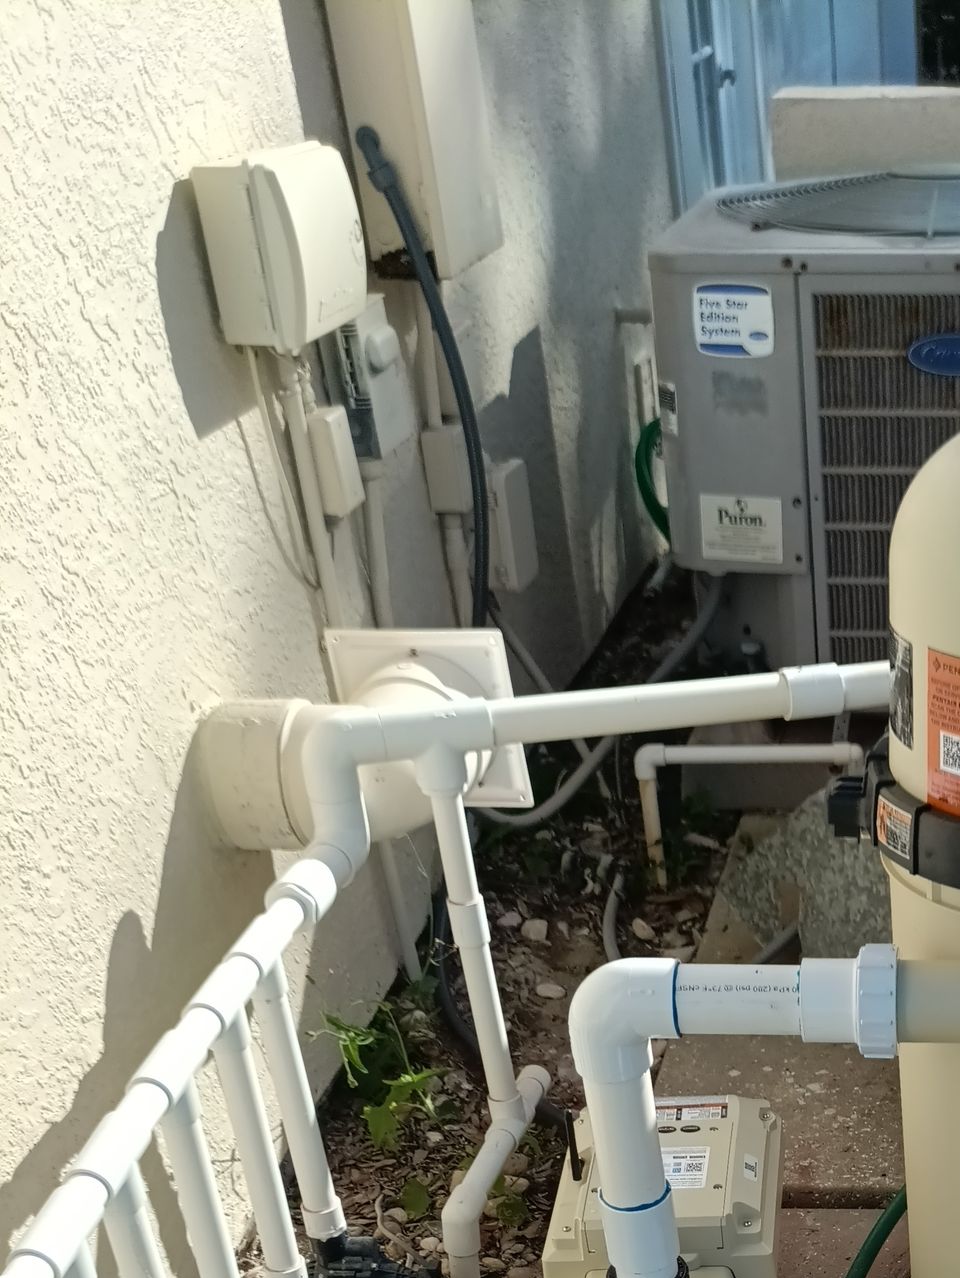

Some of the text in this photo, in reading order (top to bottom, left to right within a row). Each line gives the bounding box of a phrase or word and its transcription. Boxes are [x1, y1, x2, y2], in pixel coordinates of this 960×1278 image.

[726, 299, 748, 310] Star
[700, 312, 739, 323] Edition
[701, 325, 741, 340] System
